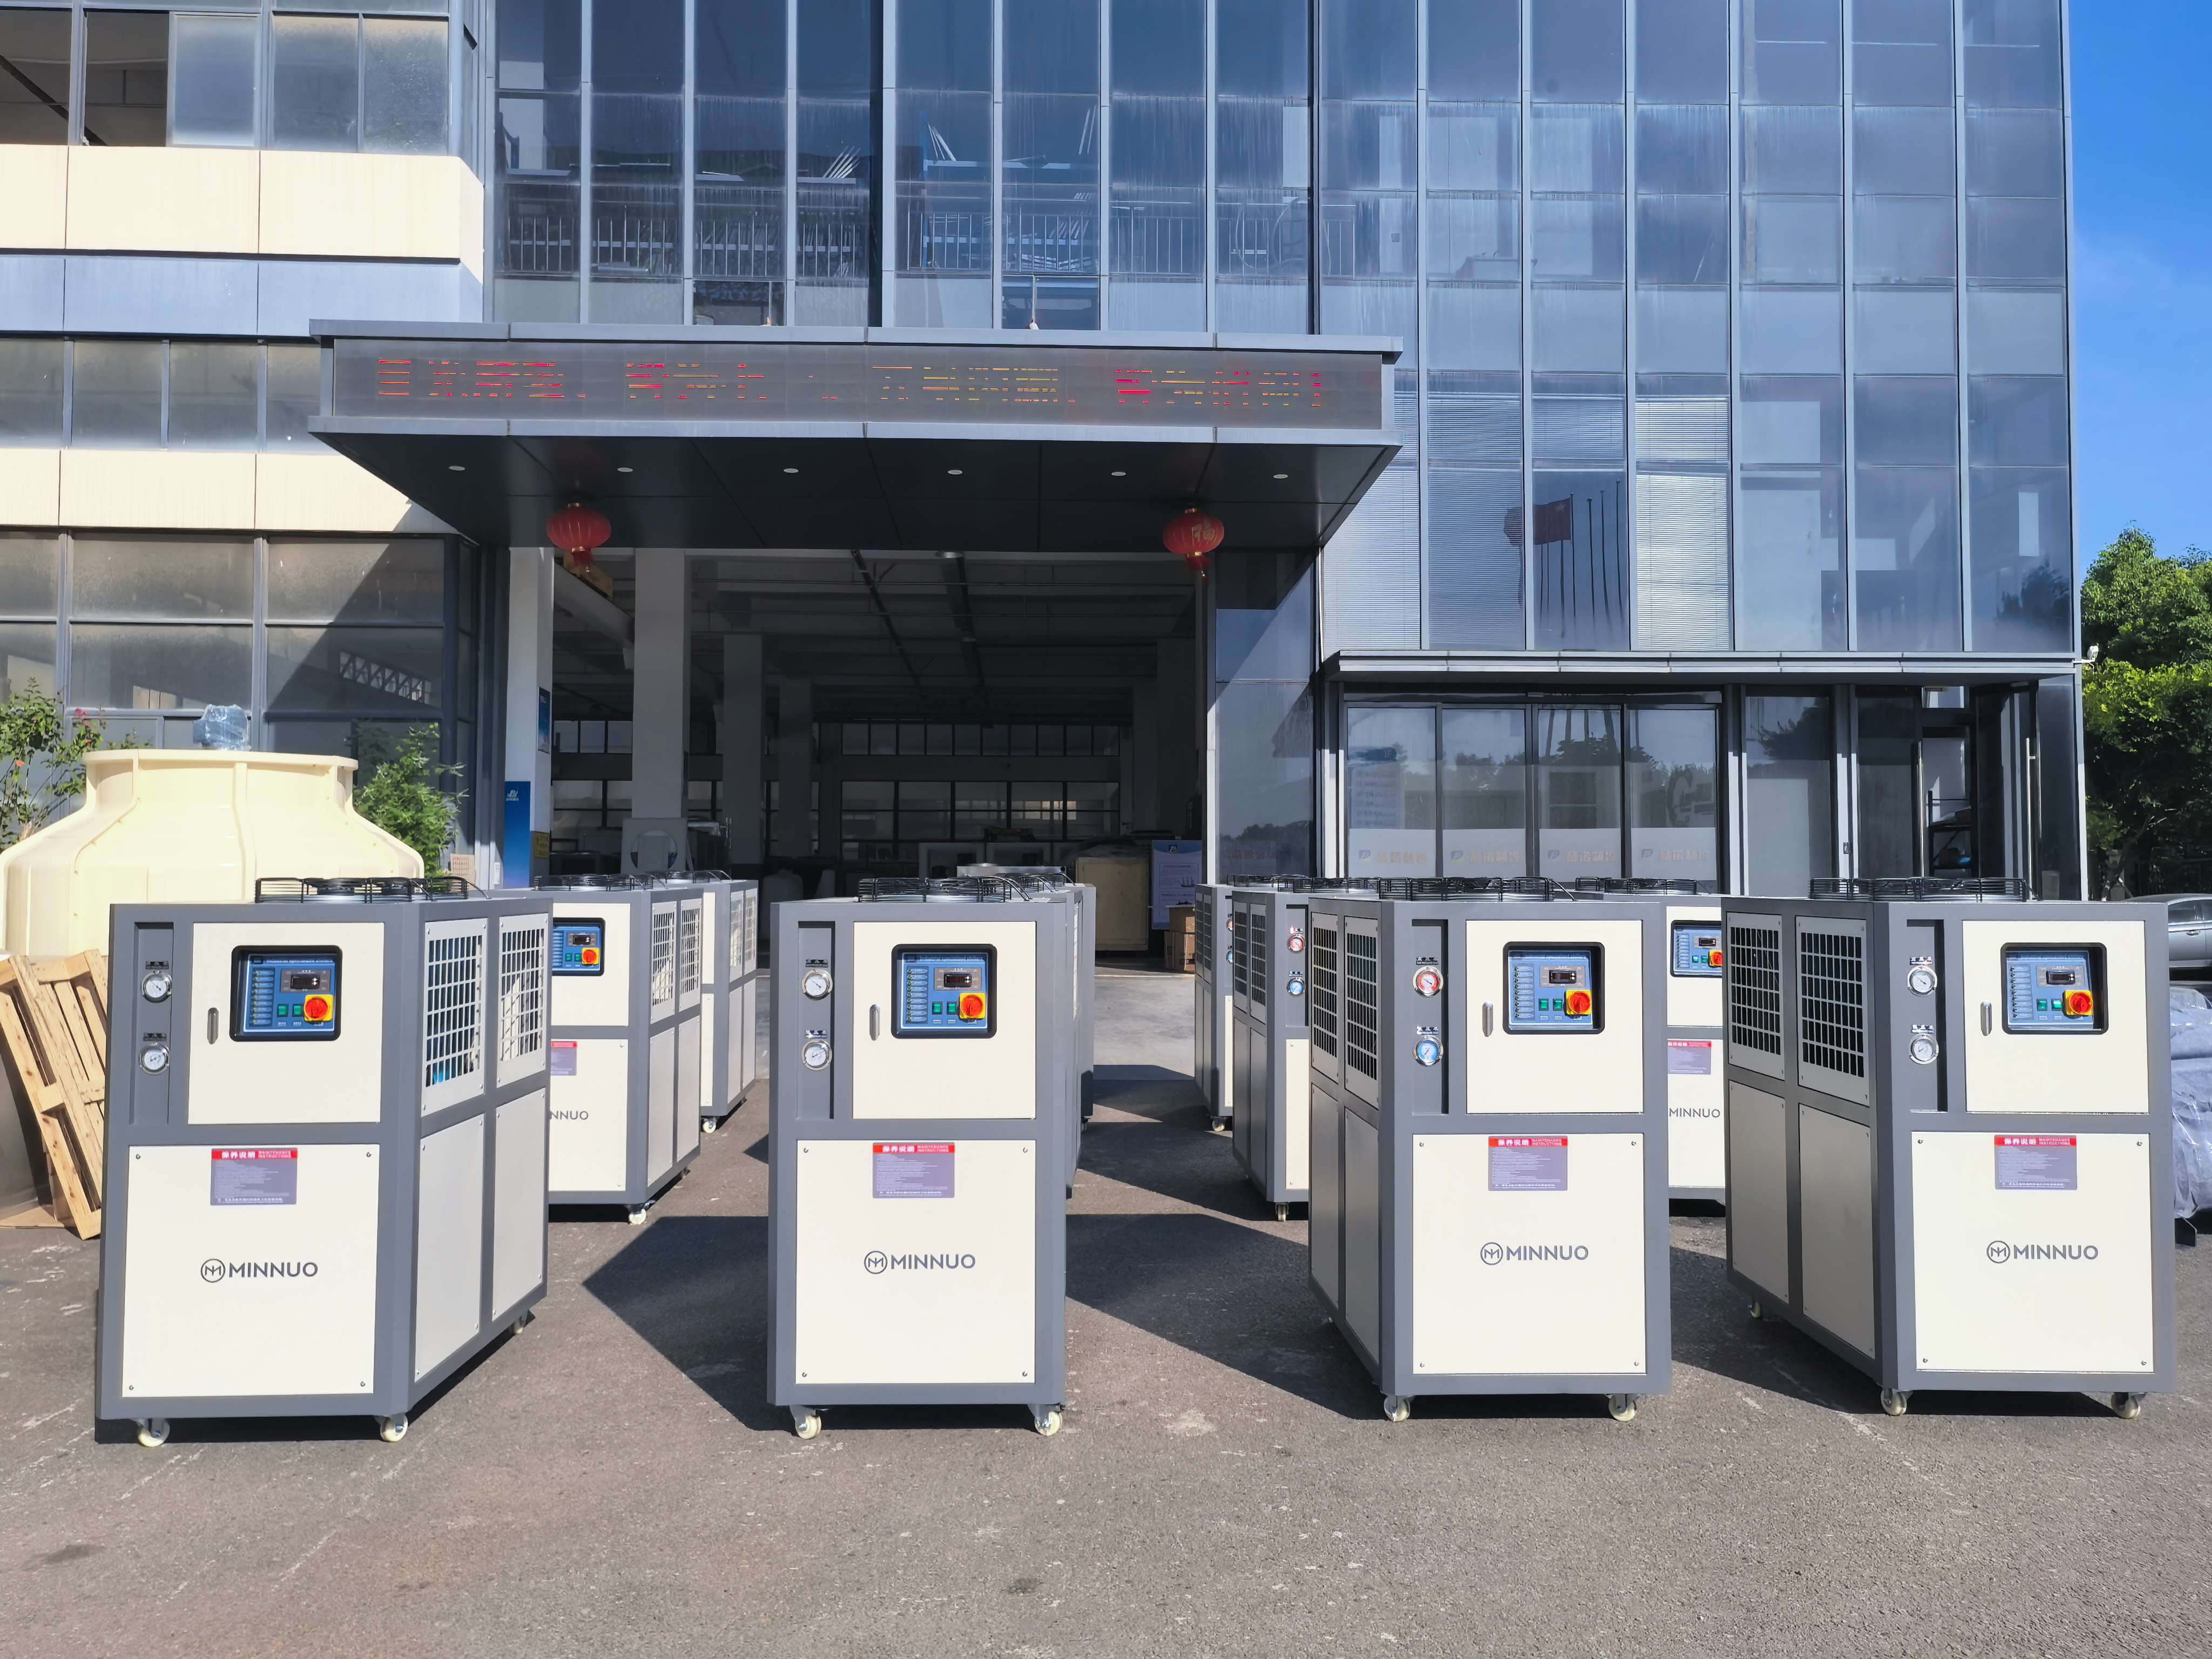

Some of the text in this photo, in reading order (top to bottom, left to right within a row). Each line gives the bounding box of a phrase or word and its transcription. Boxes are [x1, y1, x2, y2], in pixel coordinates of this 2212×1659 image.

[550, 1110, 589, 1120] NNUO
[1669, 1108, 1721, 1118] MINNUO
[1506, 1245, 1589, 1260] MINNUO
[2013, 1244, 2099, 1260] MINNUO
[891, 1254, 975, 1269] MINNUO
[229, 1262, 318, 1277] MINNUO
